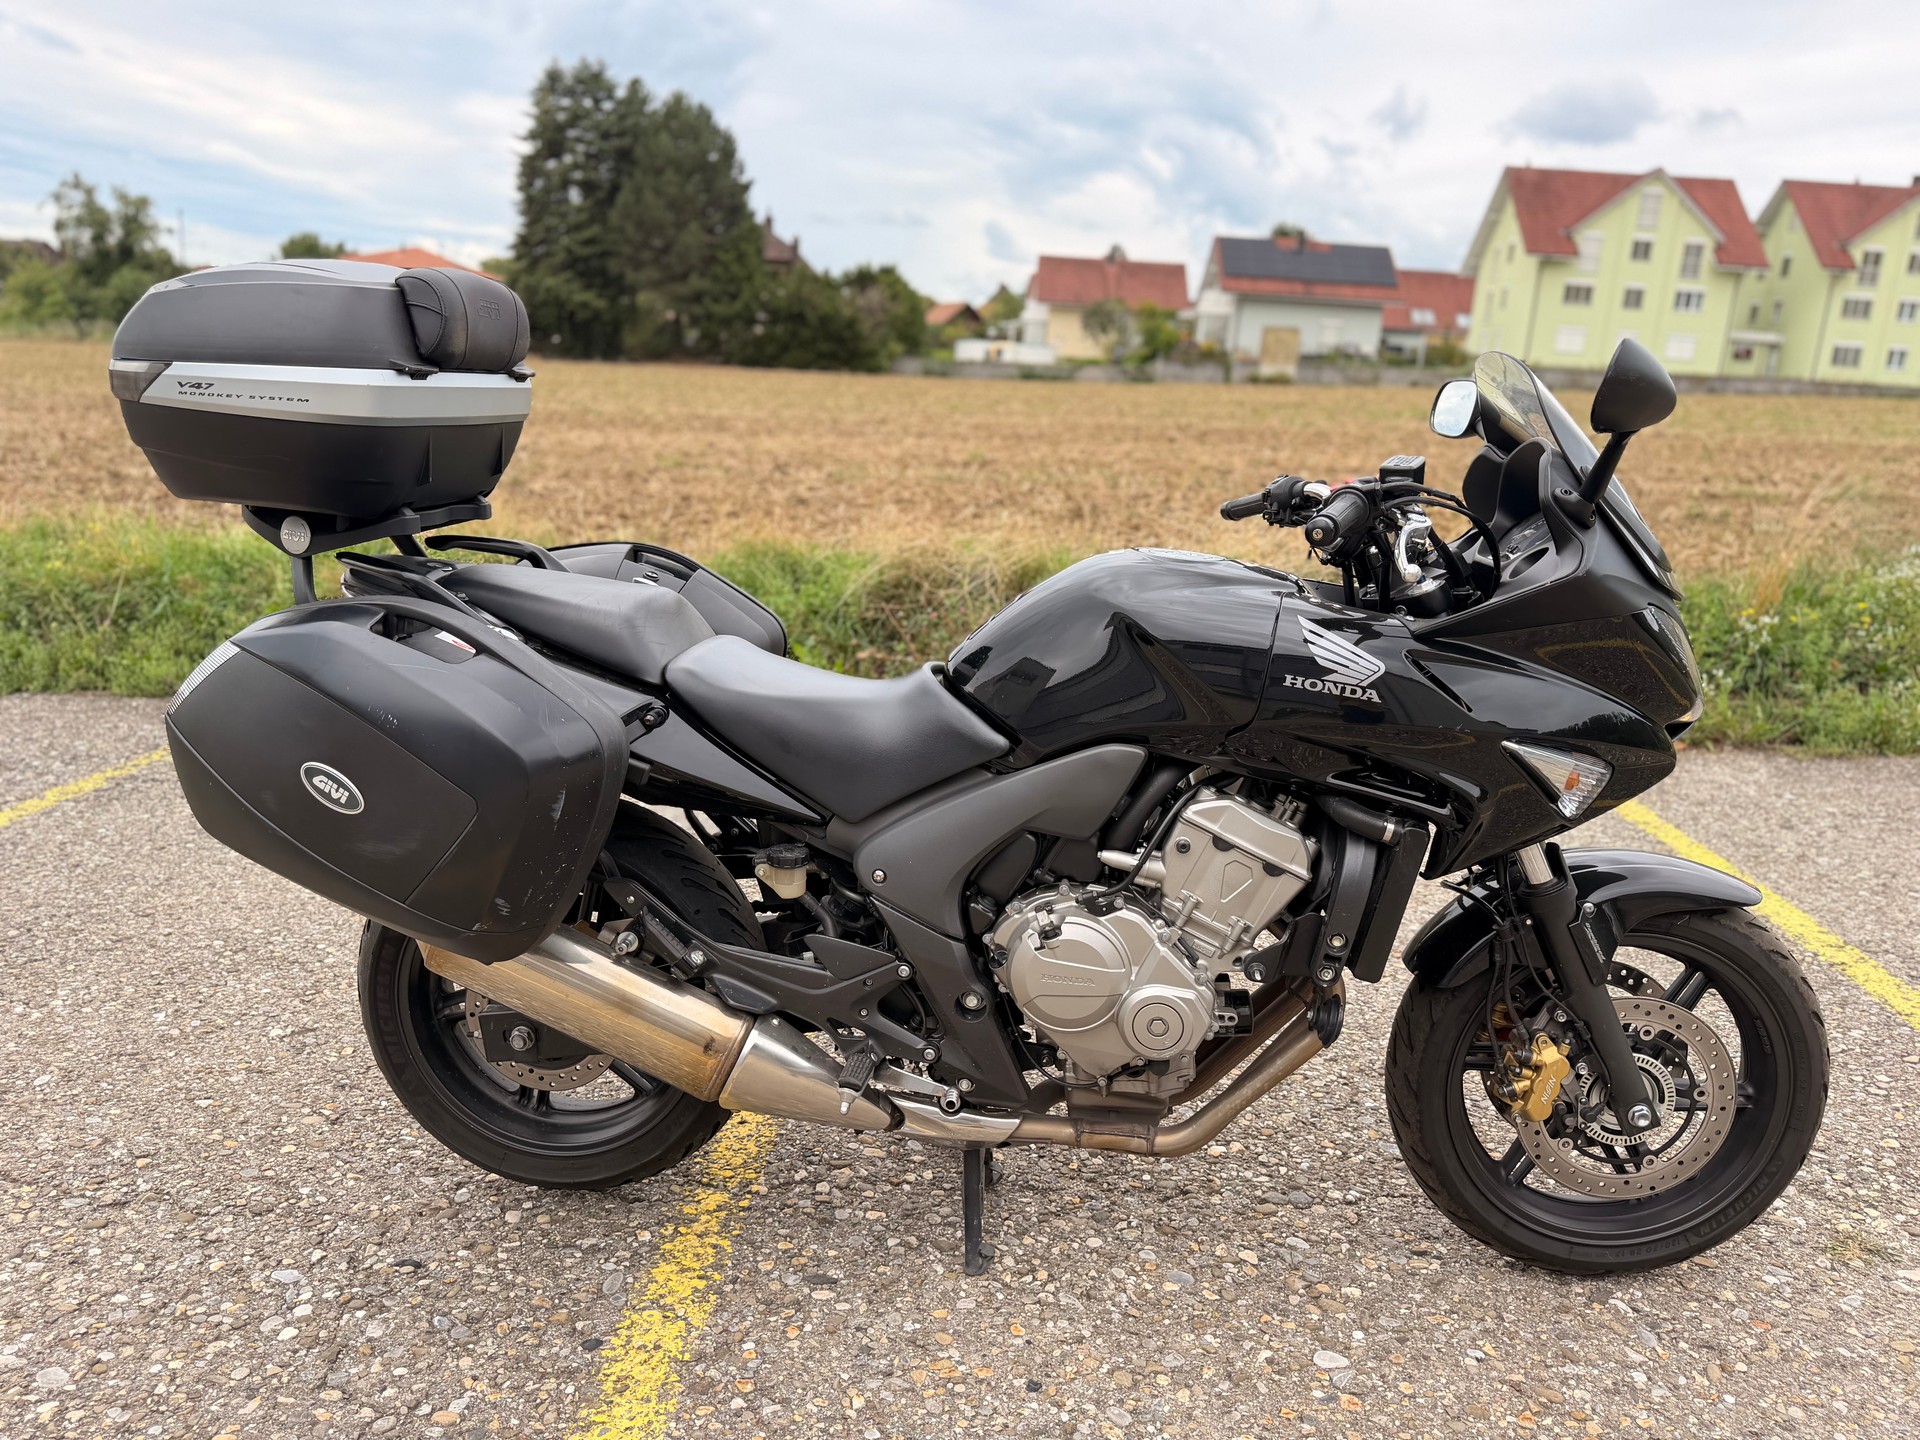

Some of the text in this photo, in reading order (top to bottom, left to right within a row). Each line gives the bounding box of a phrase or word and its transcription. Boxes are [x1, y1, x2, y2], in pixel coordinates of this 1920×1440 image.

[177, 381, 215, 391] V47
[178, 391, 243, 399] MONOKEY
[1283, 674, 1382, 703] HONDA
[312, 775, 350, 804] GIVI
[1040, 974, 1096, 987] HONDA
[1541, 1074, 1557, 1104] NISSIN
[1699, 1175, 1770, 1236] MICHELIN
